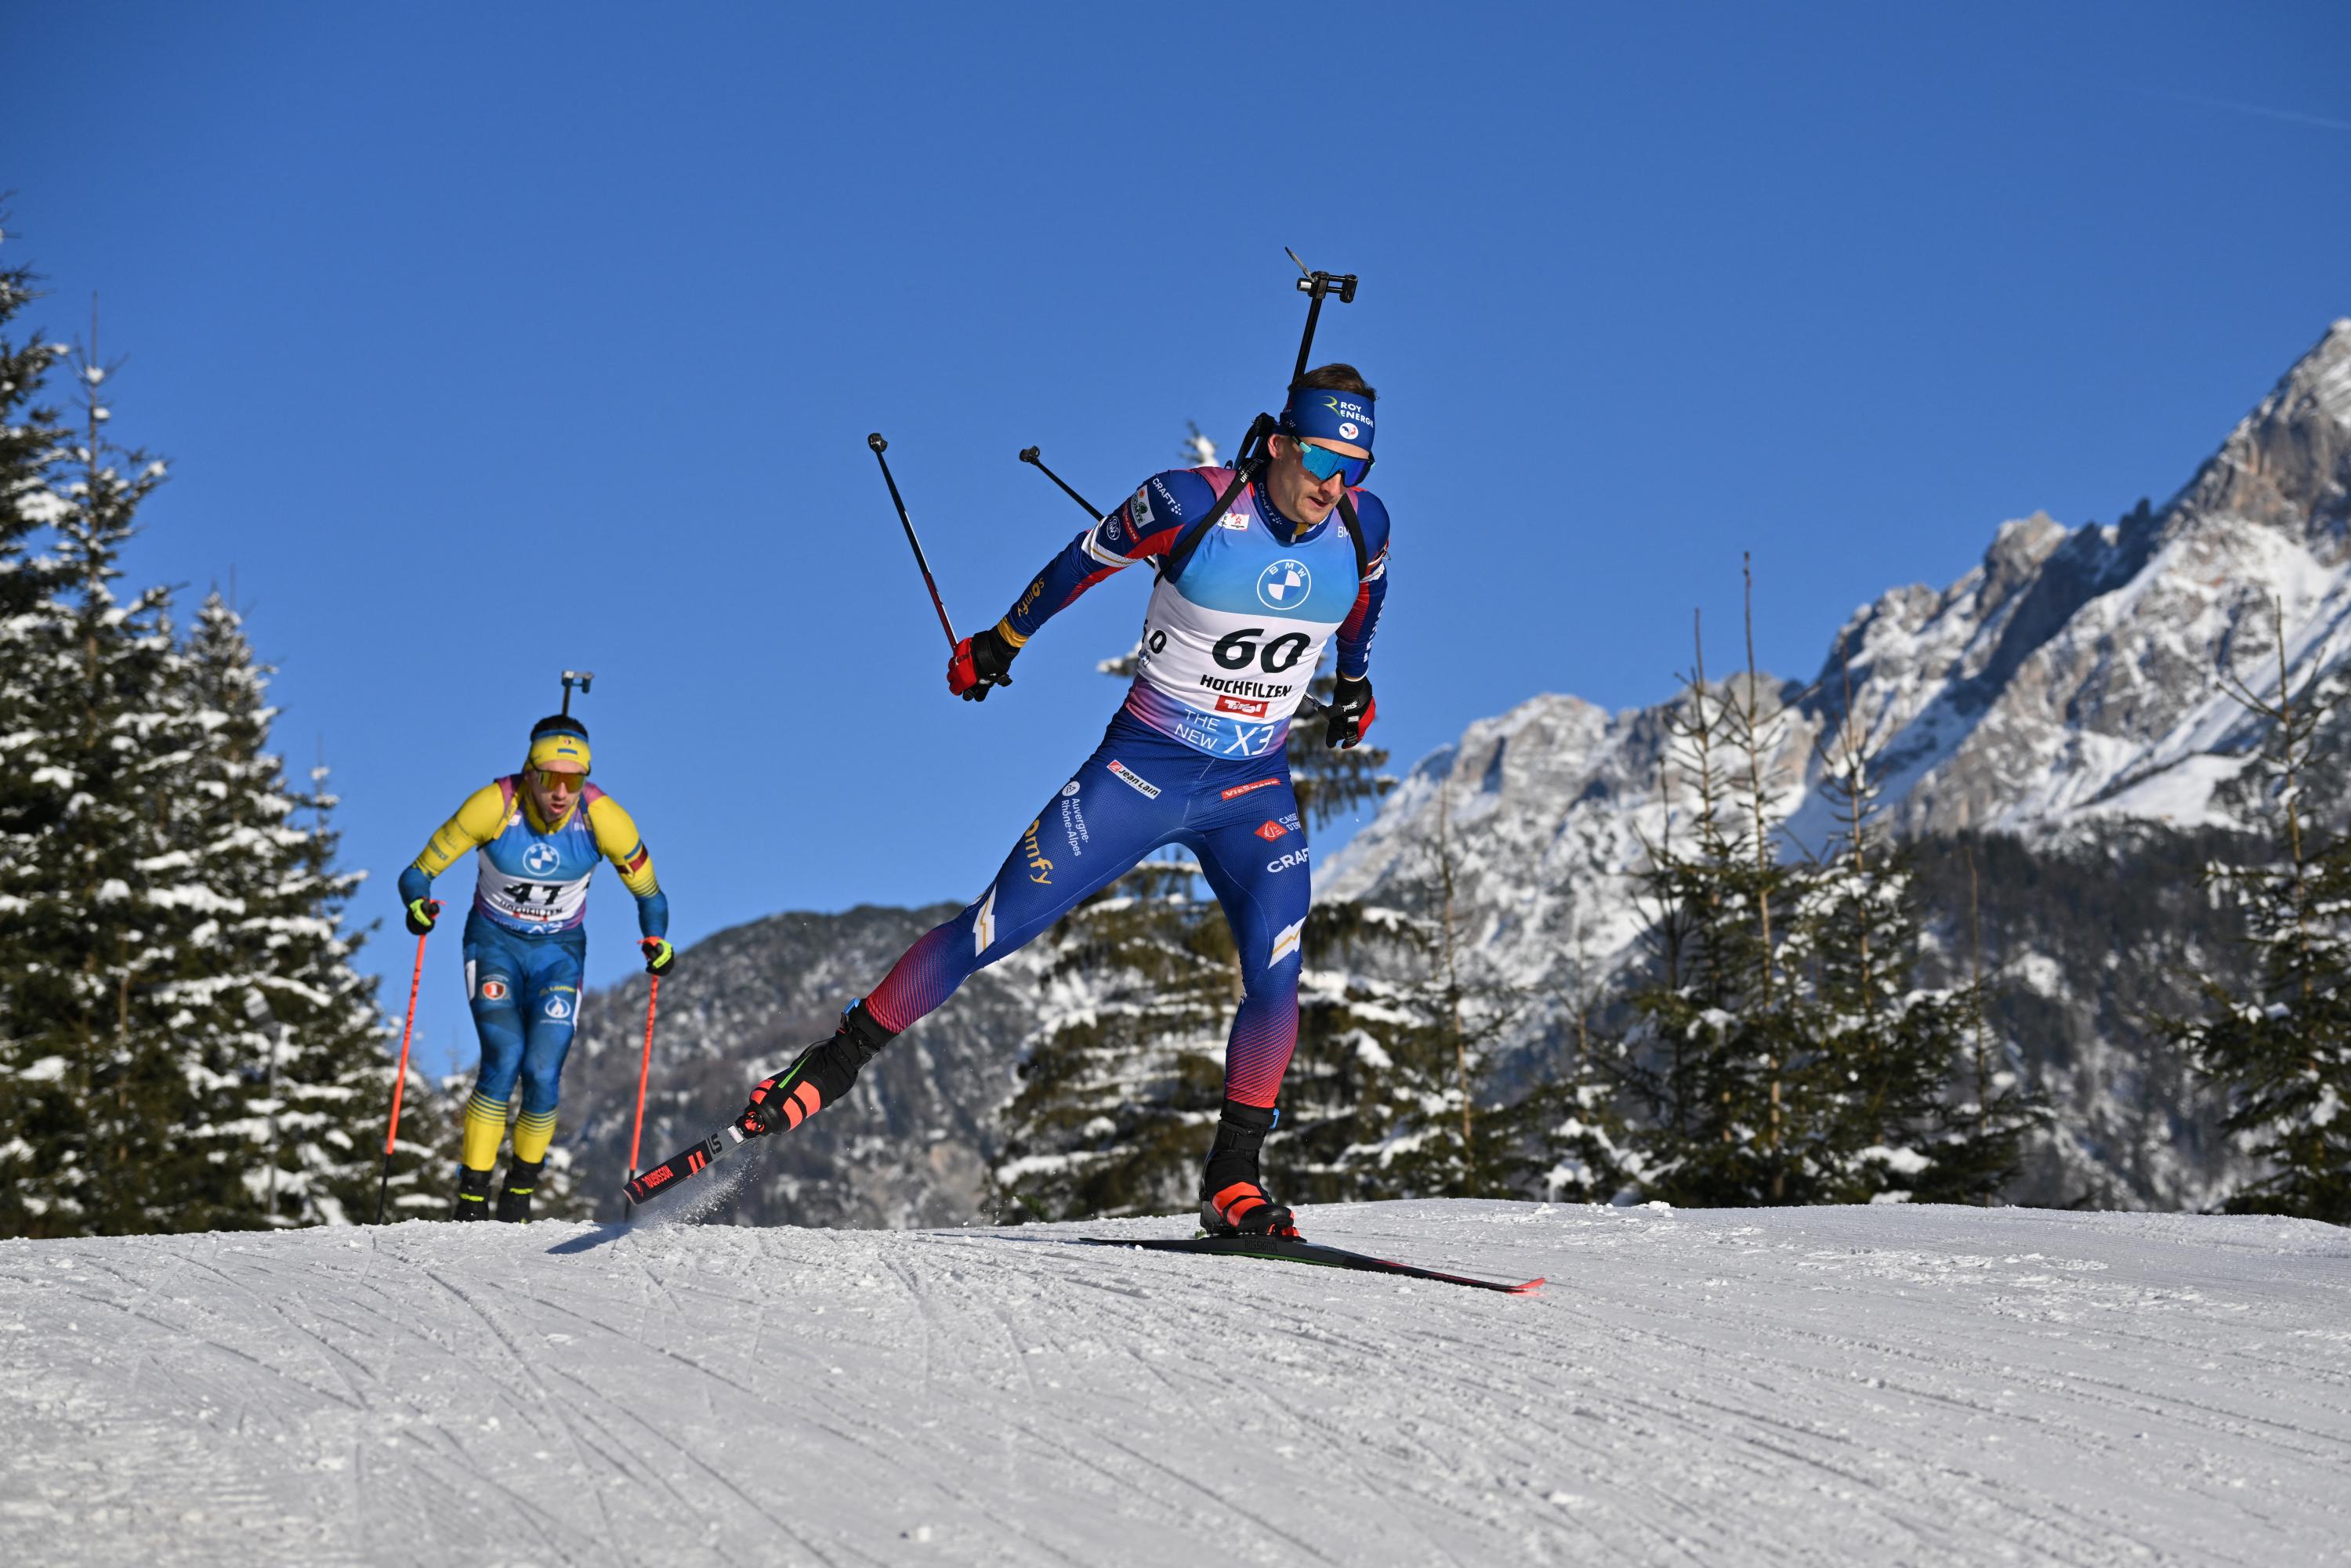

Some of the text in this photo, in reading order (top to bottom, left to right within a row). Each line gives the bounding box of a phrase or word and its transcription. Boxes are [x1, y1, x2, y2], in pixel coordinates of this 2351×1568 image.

[1341, 402, 1361, 412] ROY
[1153, 478, 1176, 505] CRAFT
[1259, 483, 1276, 519] CRAFT
[1338, 526, 1351, 538] BM
[1269, 563, 1306, 578] BMW
[1212, 628, 1310, 673] 60
[1200, 674, 1292, 698] HOCHFILZEN
[1224, 699, 1262, 714] Tirol
[1184, 708, 1220, 732] THE
[1175, 723, 1218, 750] NEW
[1223, 725, 1275, 756] X3
[1061, 799, 1081, 856] Rhône-Alpes
[1072, 798, 1089, 843] Auvergne-
[1025, 819, 1053, 884] omfy
[641, 1164, 674, 1190] ROSSIGNOL
[1244, 1240, 1279, 1253] ROSSIGNOL
